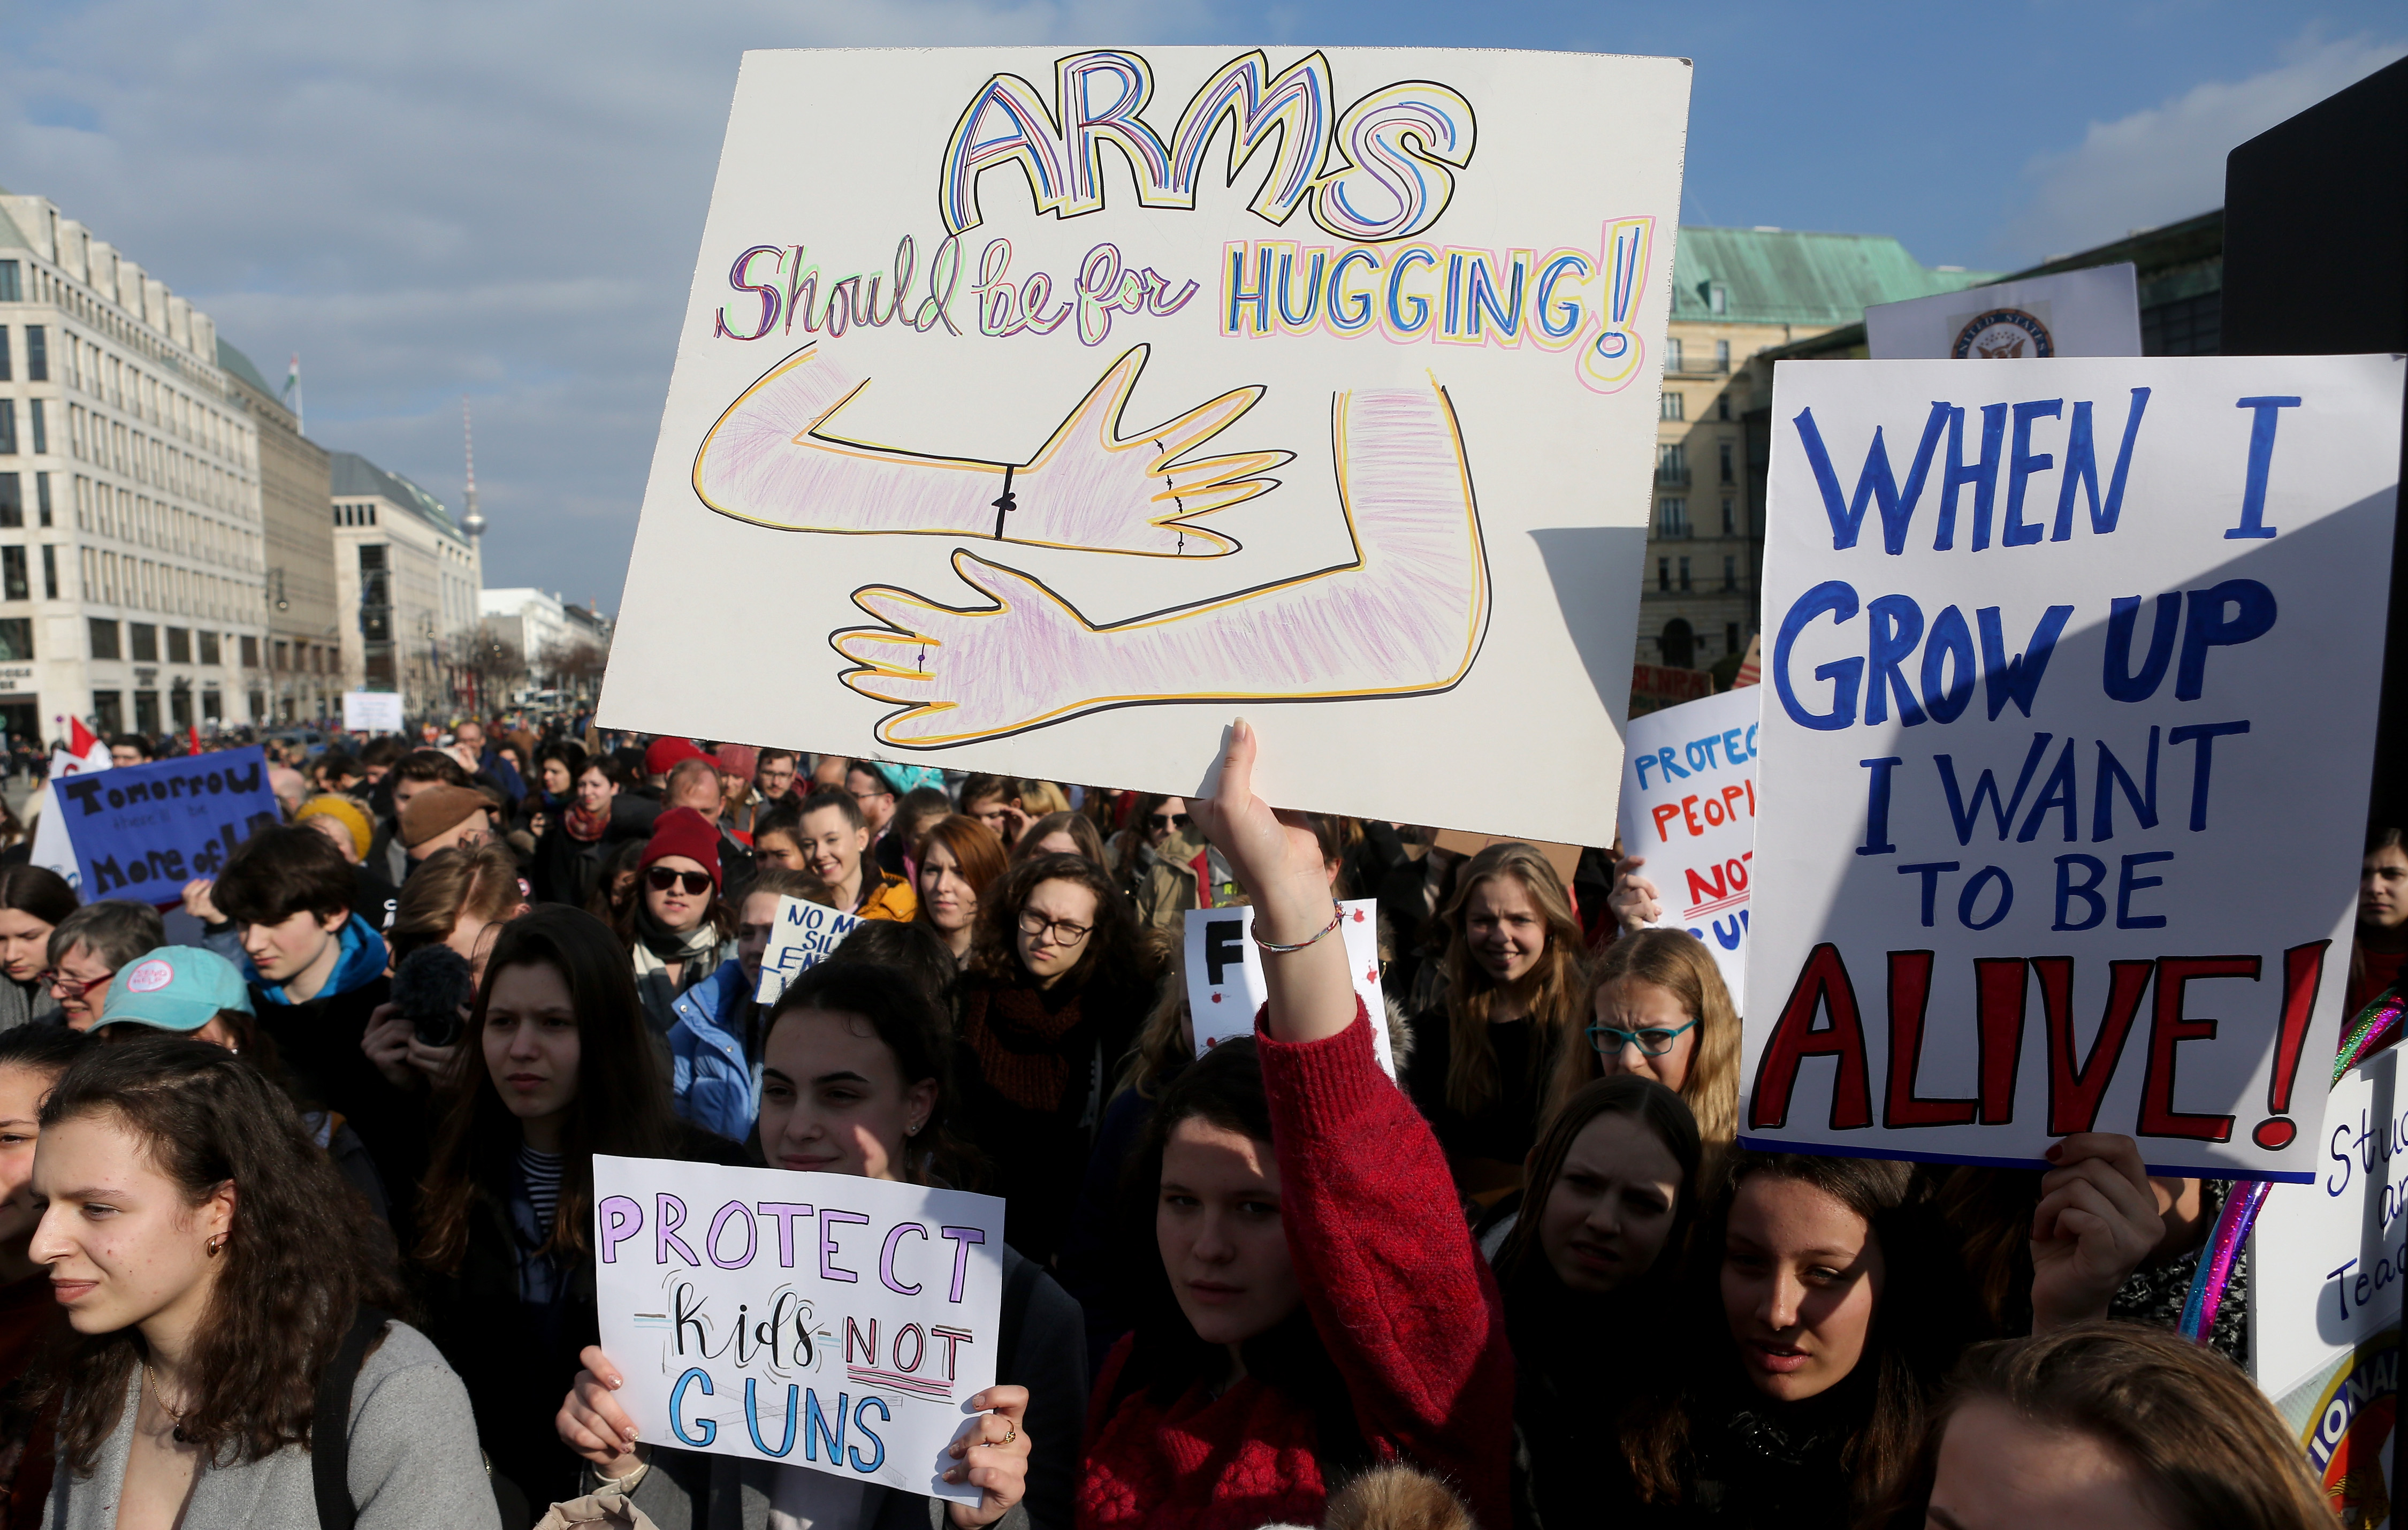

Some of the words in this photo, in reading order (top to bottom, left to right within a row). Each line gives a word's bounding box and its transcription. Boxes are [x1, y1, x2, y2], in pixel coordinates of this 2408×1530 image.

[939, 49, 1477, 242] ARMS
[713, 234, 962, 339] Should
[972, 237, 1073, 338] be
[1073, 242, 1200, 347] for
[1220, 216, 1655, 393] HUGGING!
[1959, 316, 1995, 357] NITED
[2006, 314, 2045, 351] STATES
[1793, 387, 2151, 554] WHEN
[2224, 396, 2302, 539] I
[1773, 580, 2074, 730] GROW
[2102, 578, 2277, 702] UP
[1634, 721, 1759, 790] PROTEC
[1856, 757, 1902, 856] I
[1934, 720, 2250, 846] WANT
[194, 839, 222, 873] of
[1897, 861, 2014, 931] TO
[2051, 851, 2174, 931] BE
[788, 904, 824, 929] NO
[830, 915, 869, 934] M
[1748, 939, 2332, 1152] ALIVE!
[599, 1193, 985, 1303] PROTECT
[675, 1282, 825, 1368] kids
[846, 1316, 973, 1380] NOT
[669, 1367, 891, 1473] GUNS
